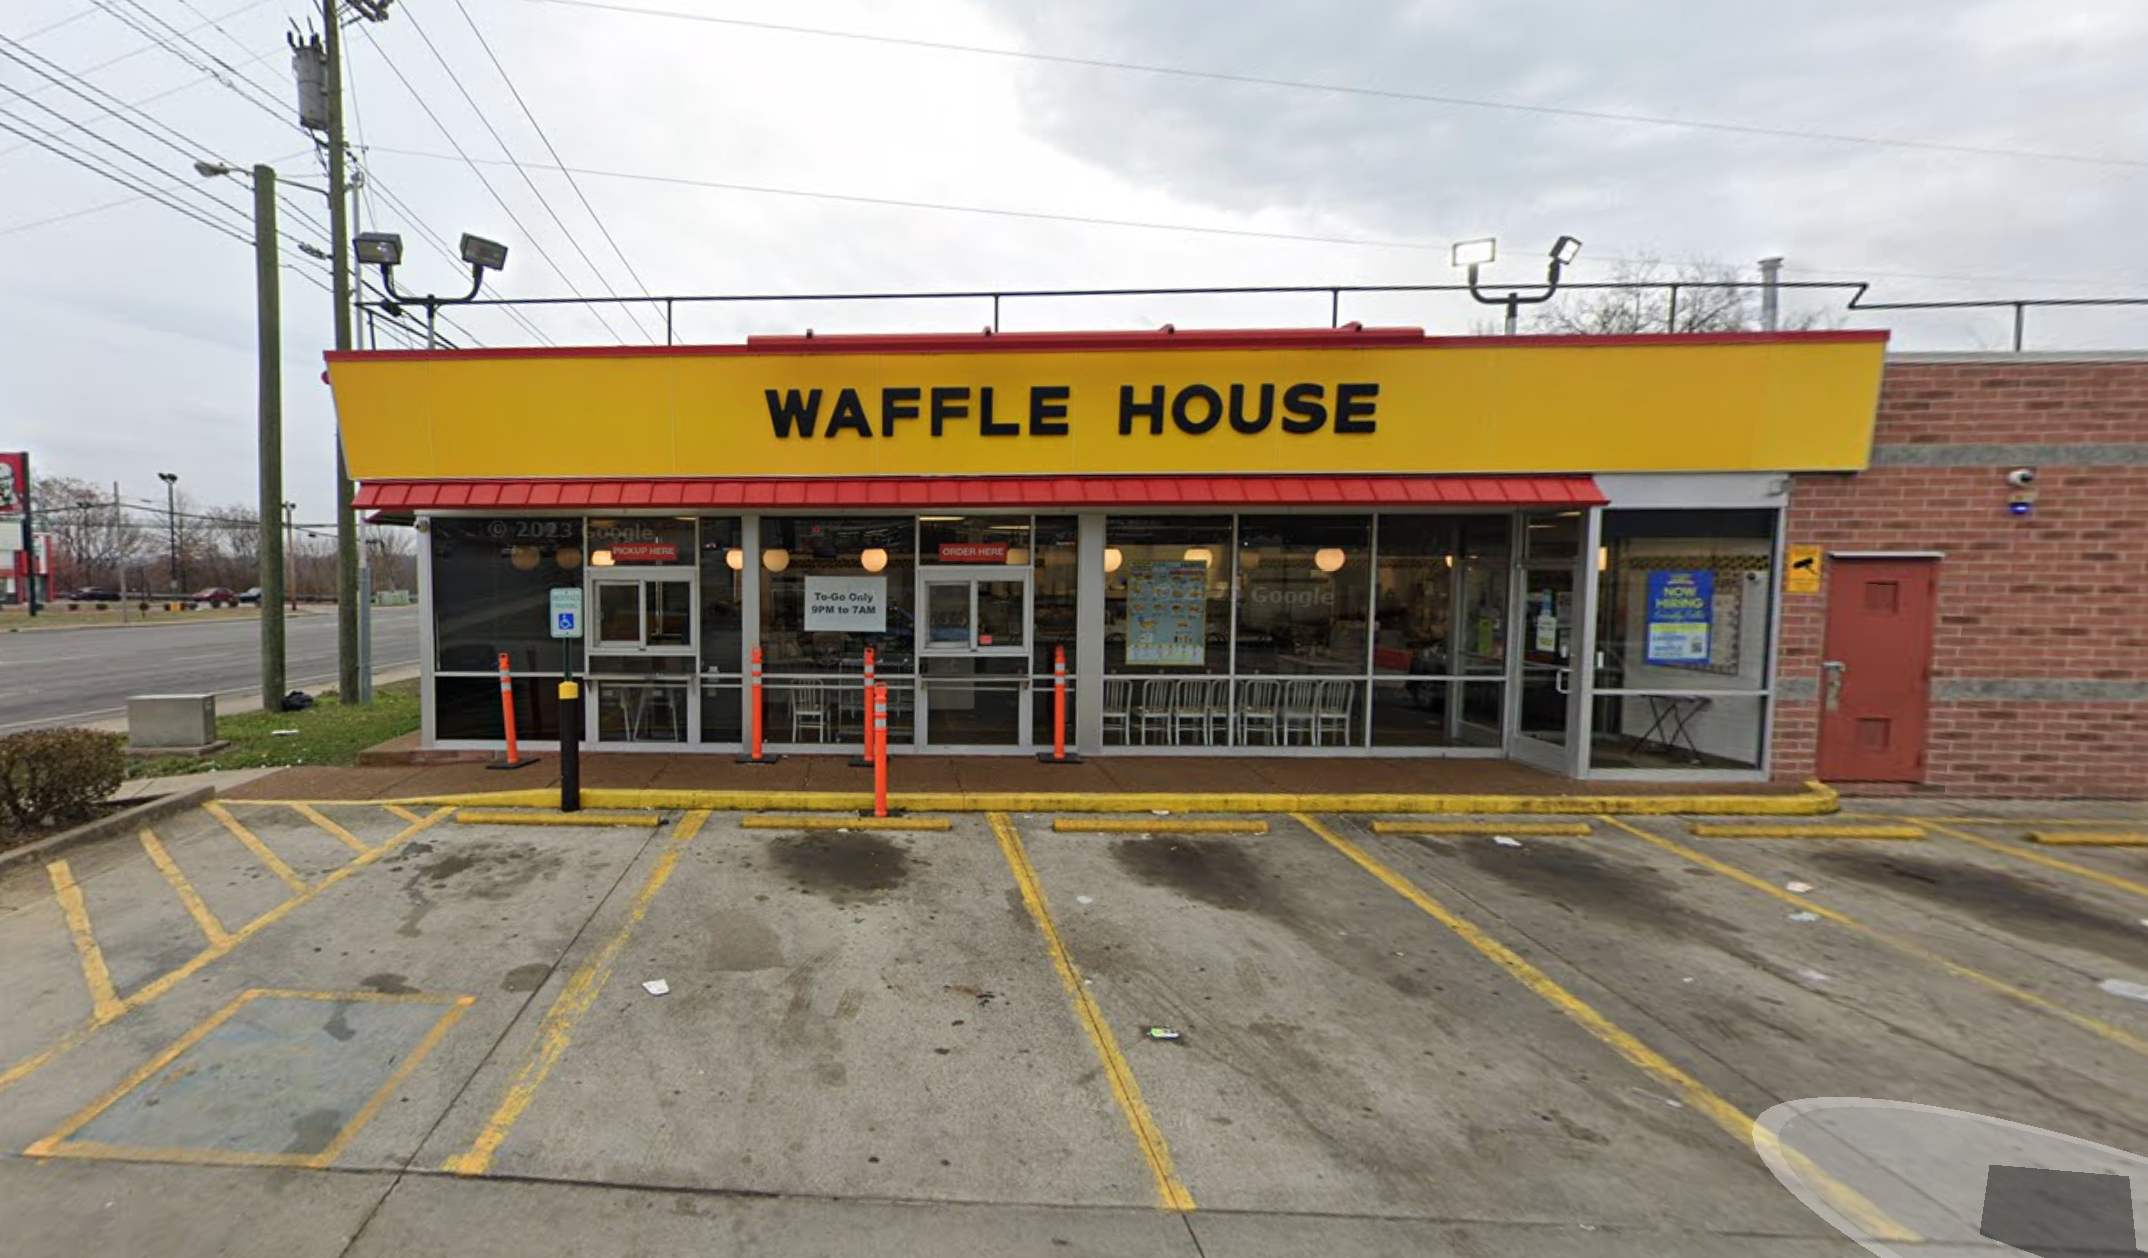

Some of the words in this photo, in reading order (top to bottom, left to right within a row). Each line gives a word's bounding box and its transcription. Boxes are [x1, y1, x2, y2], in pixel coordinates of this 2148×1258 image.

[764, 385, 1071, 439] WAFFLE
[1118, 382, 1381, 436] HOUSE
[612, 546, 647, 555] PICKUP
[649, 546, 676, 555] HERE
[942, 546, 977, 556] ORDER
[978, 546, 1005, 556] HERE
[1663, 586, 1697, 598] NOW
[814, 592, 846, 602] To-Go
[849, 592, 874, 604] Only
[810, 605, 835, 615] 9PM
[837, 605, 850, 615] to
[852, 605, 877, 615] 7AM
